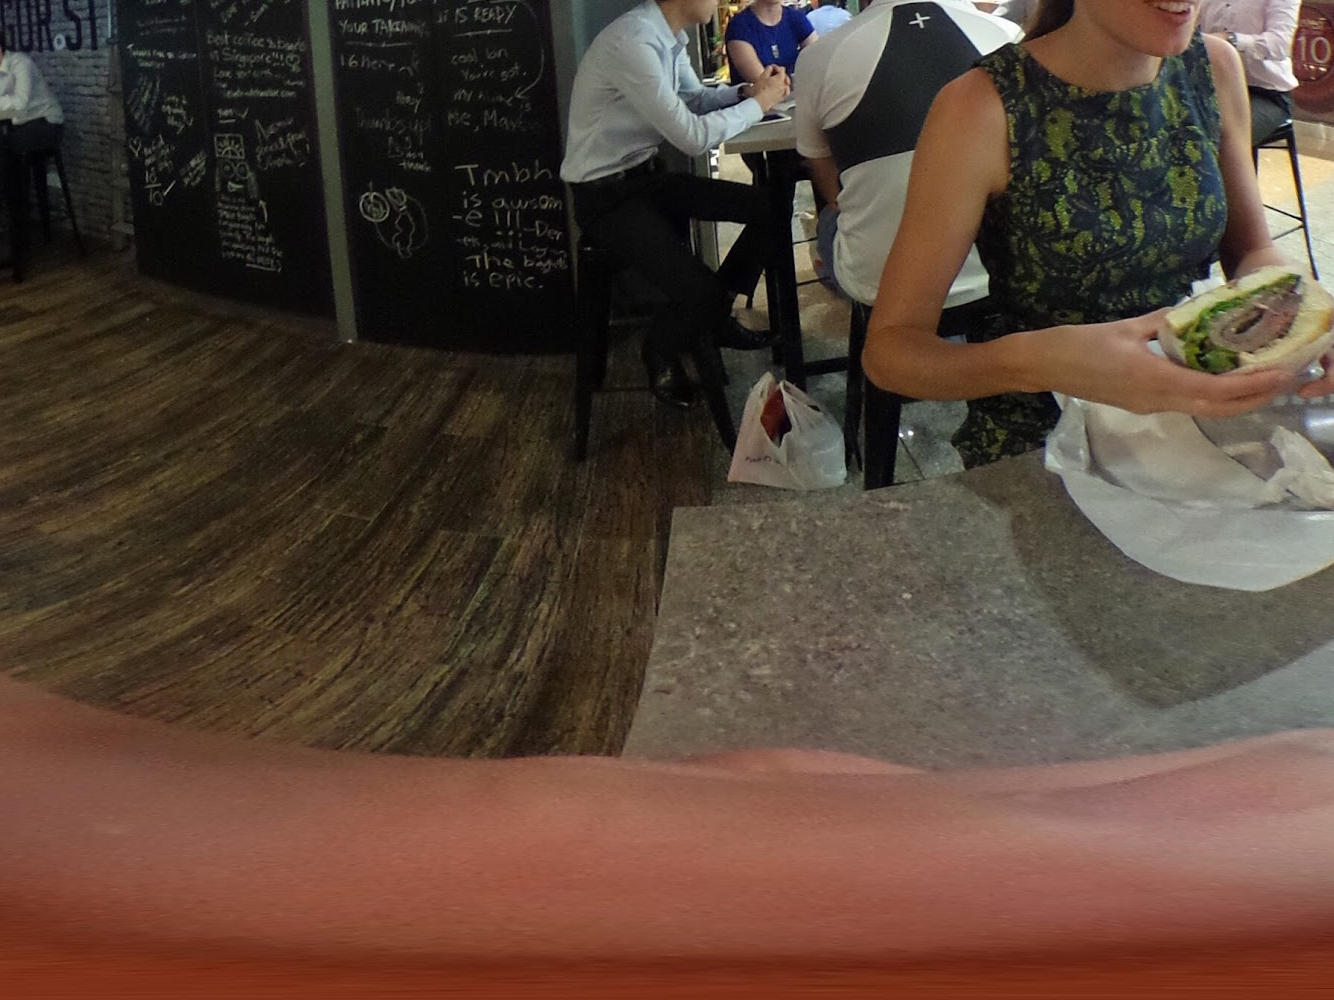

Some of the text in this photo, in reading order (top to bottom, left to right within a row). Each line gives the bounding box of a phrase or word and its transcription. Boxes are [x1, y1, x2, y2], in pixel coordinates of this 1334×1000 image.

[454, 6, 467, 24] IS
[474, 5, 517, 24] READY
[338, 19, 368, 36] YOUR
[463, 190, 482, 208] is
[465, 250, 515, 270] The
[463, 270, 480, 287] is
